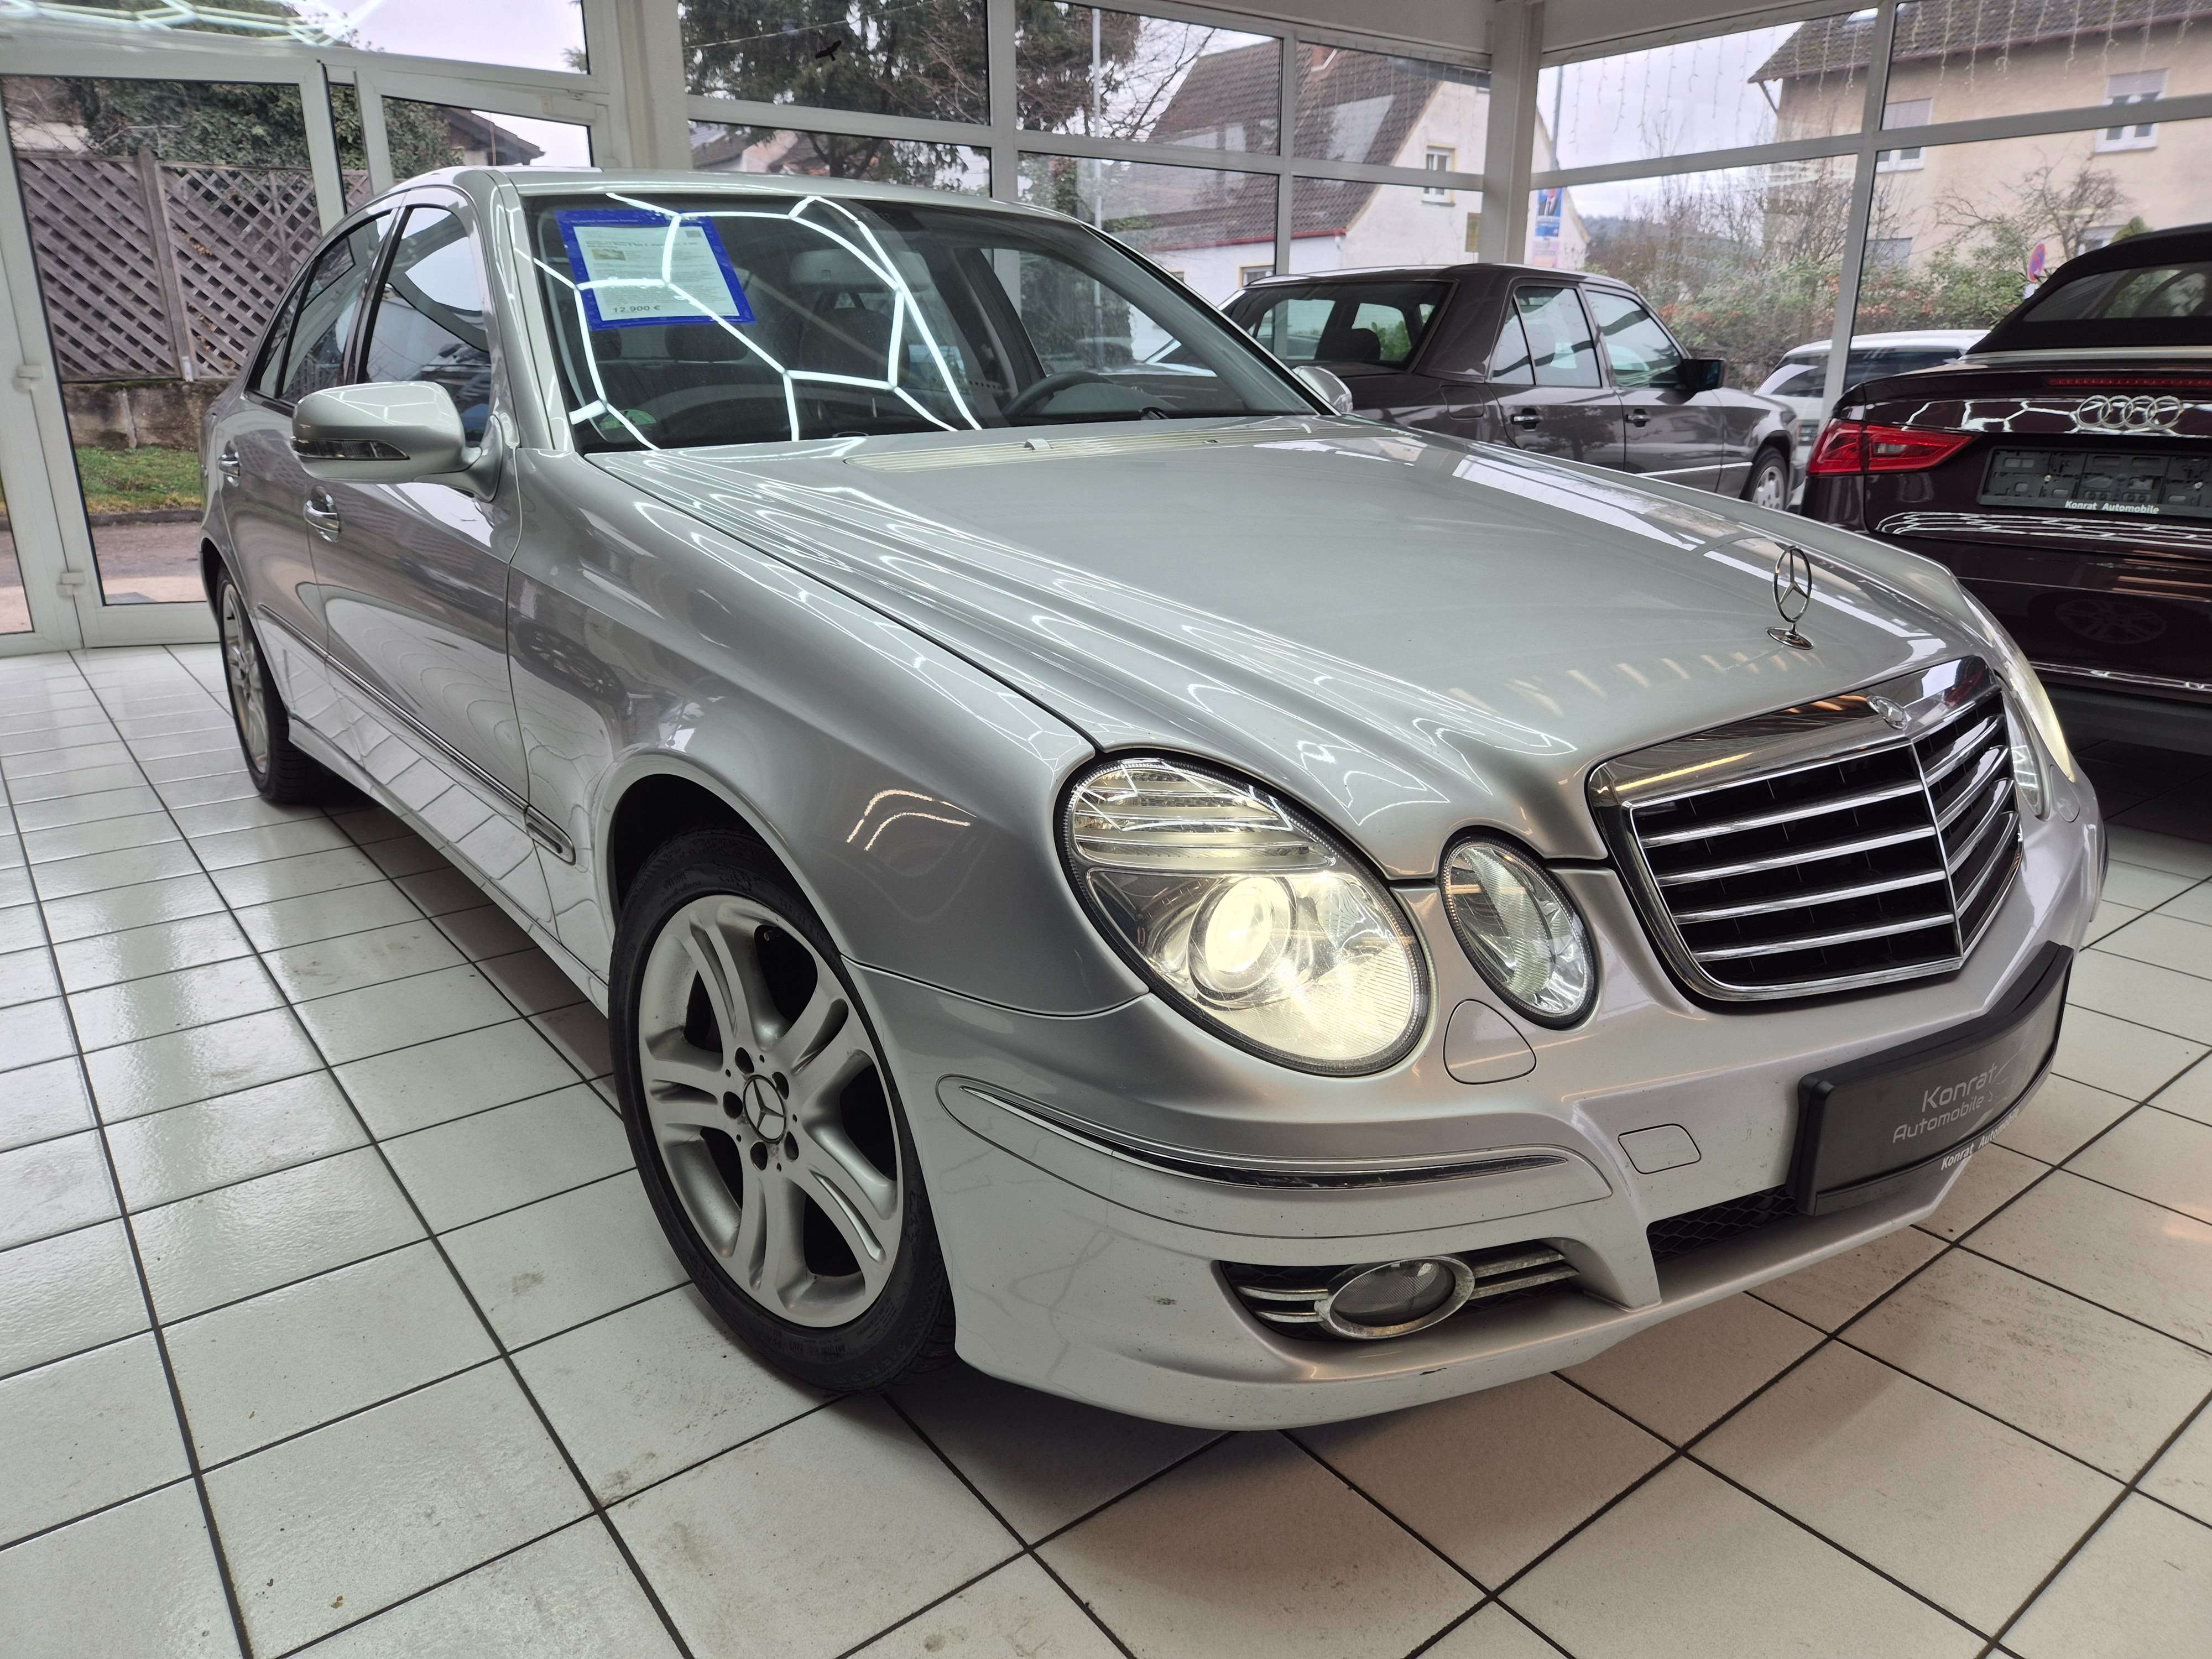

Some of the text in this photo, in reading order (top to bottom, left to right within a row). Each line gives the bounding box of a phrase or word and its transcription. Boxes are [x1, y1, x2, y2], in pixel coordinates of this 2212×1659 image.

[2065, 500, 2159, 514] Konrat Automobile
[1922, 1062, 1997, 1113] Konrat
[1892, 1095, 1984, 1143] Automobile
[1941, 1142, 1975, 1171] Konrat
